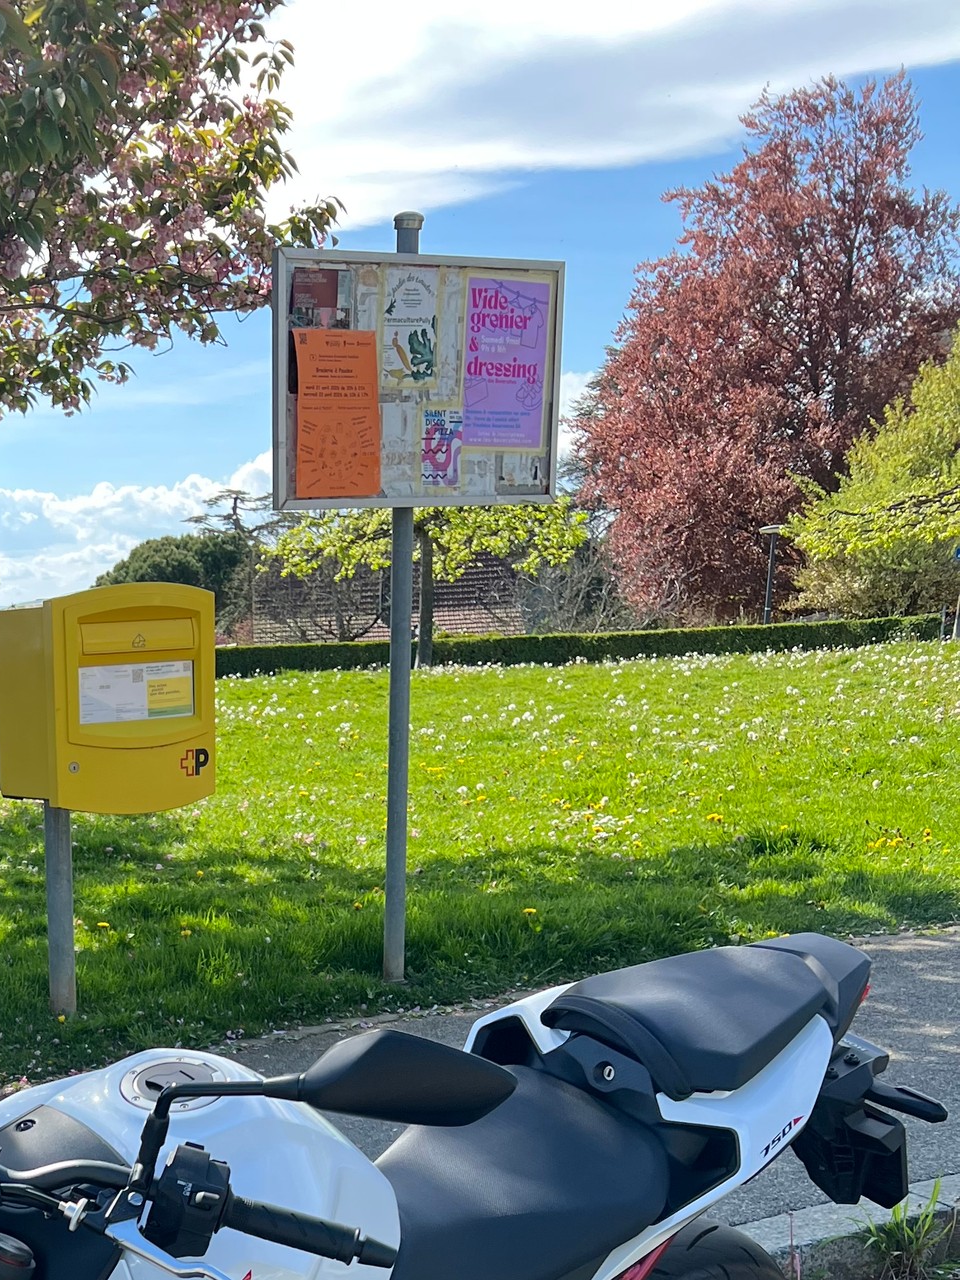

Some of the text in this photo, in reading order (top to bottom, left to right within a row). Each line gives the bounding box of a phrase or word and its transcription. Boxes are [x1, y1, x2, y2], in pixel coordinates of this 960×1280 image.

[471, 288, 508, 310] Vide
[471, 308, 532, 332] grenier
[469, 336, 478, 352] &
[467, 356, 538, 384] dressing
[760, 1121, 792, 1158] 750
